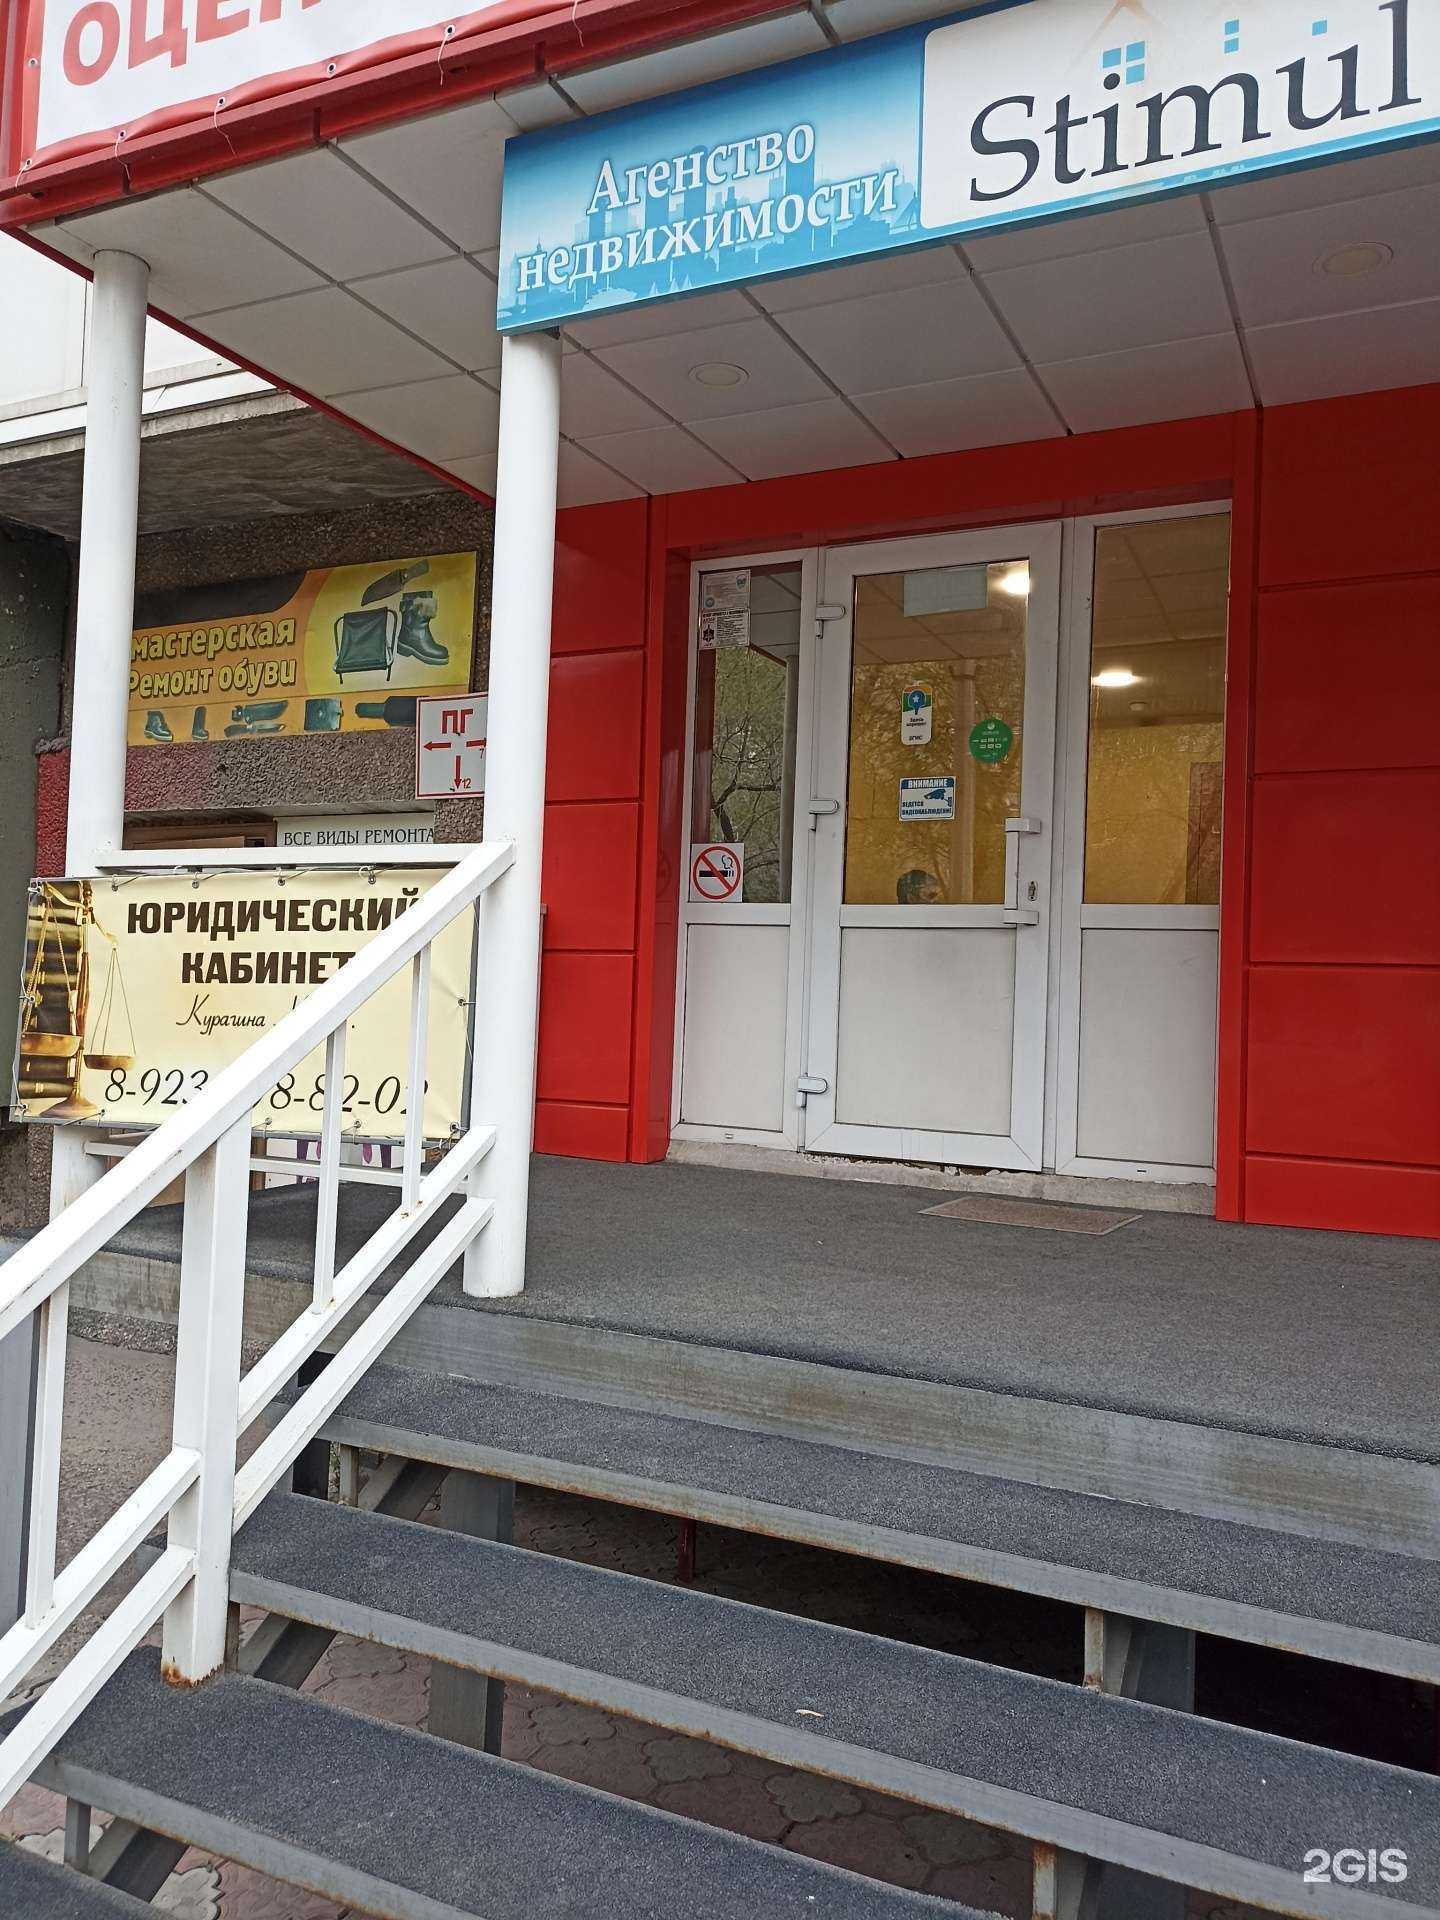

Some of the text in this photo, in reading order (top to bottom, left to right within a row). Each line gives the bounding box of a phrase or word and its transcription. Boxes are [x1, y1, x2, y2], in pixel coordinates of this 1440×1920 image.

[63, 0, 322, 86] ОЦЕ
[969, 0, 1422, 201] Stimul
[586, 123, 815, 215] Агенство
[515, 168, 899, 293] недвижимости
[130, 618, 296, 660] мастерская
[217, 658, 298, 696] обуви
[441, 708, 474, 735] ПГ
[461, 777, 472, 790] 12
[907, 778, 949, 789] ВНИМАНИЕ
[283, 828, 434, 846] ВСЕ ВИДЫ РЕМОНТА
[175, 993, 266, 1036] Курагина
